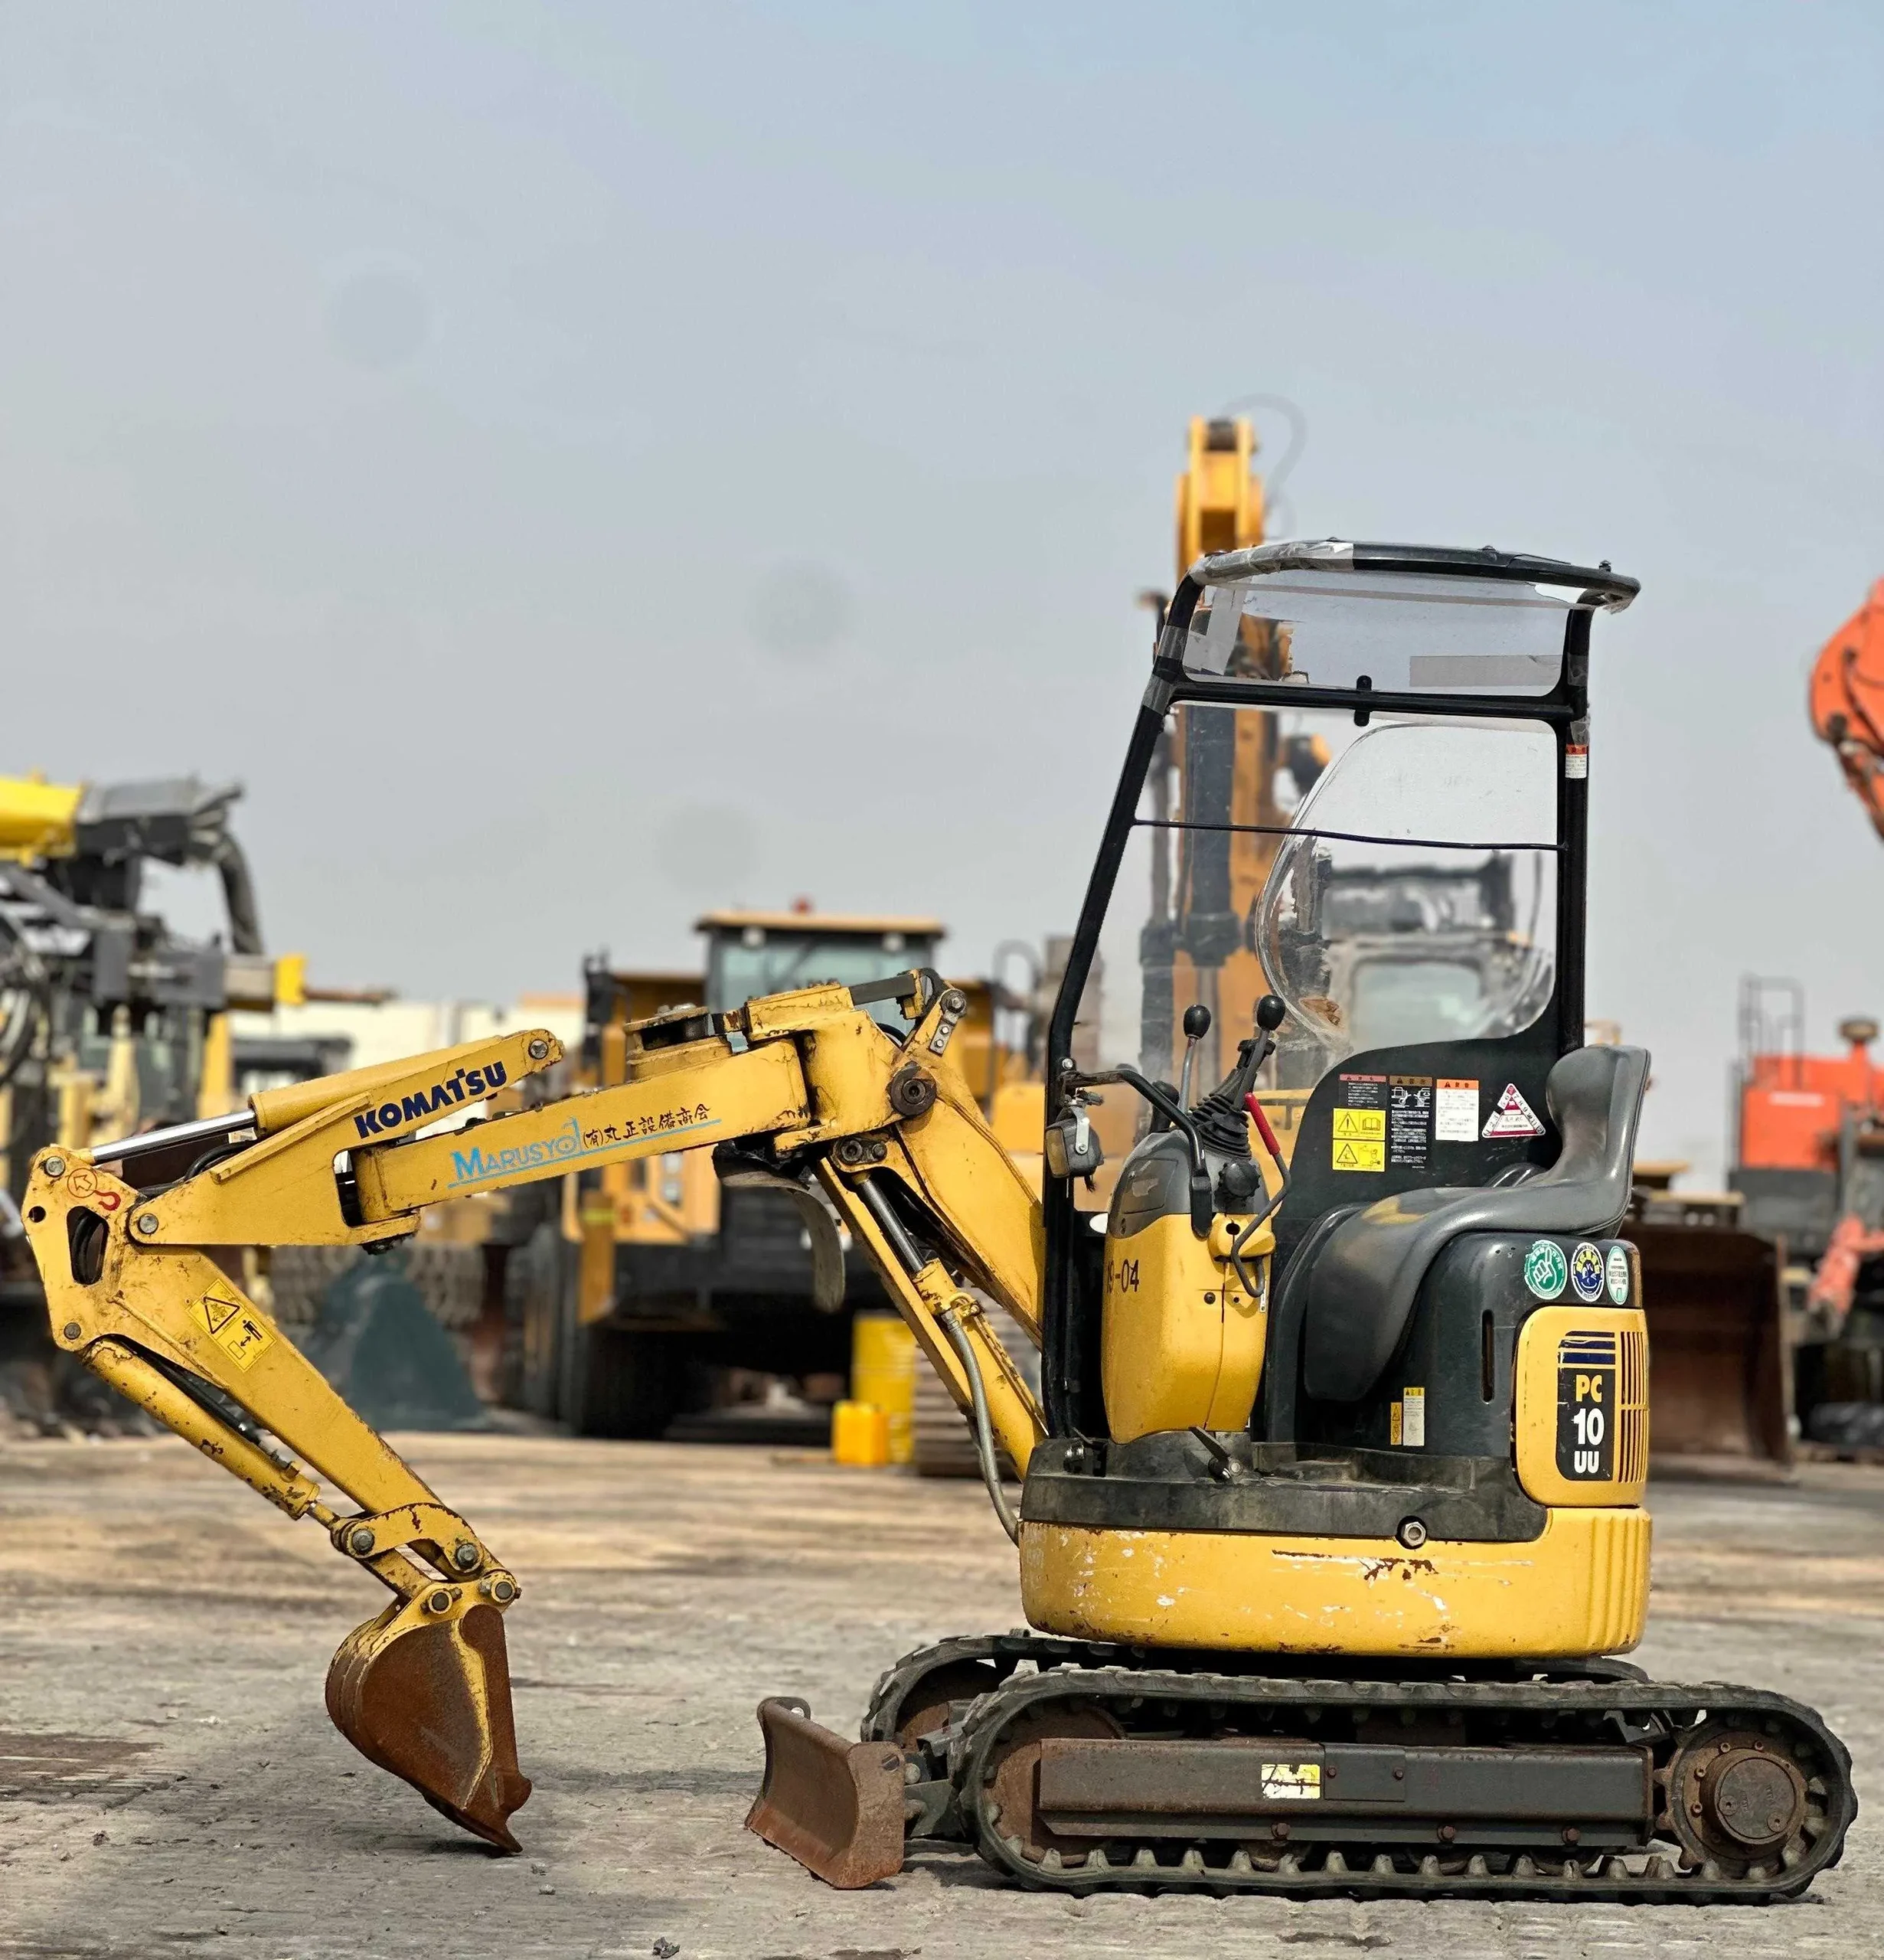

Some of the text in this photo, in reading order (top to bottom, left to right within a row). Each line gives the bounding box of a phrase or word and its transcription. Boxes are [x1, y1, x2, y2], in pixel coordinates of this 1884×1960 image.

[354, 1061, 508, 1138] KOMATSU
[1575, 1374, 1602, 1403] PC
[1573, 1408, 1605, 1446] 10
[1574, 1450, 1600, 1474] UU
